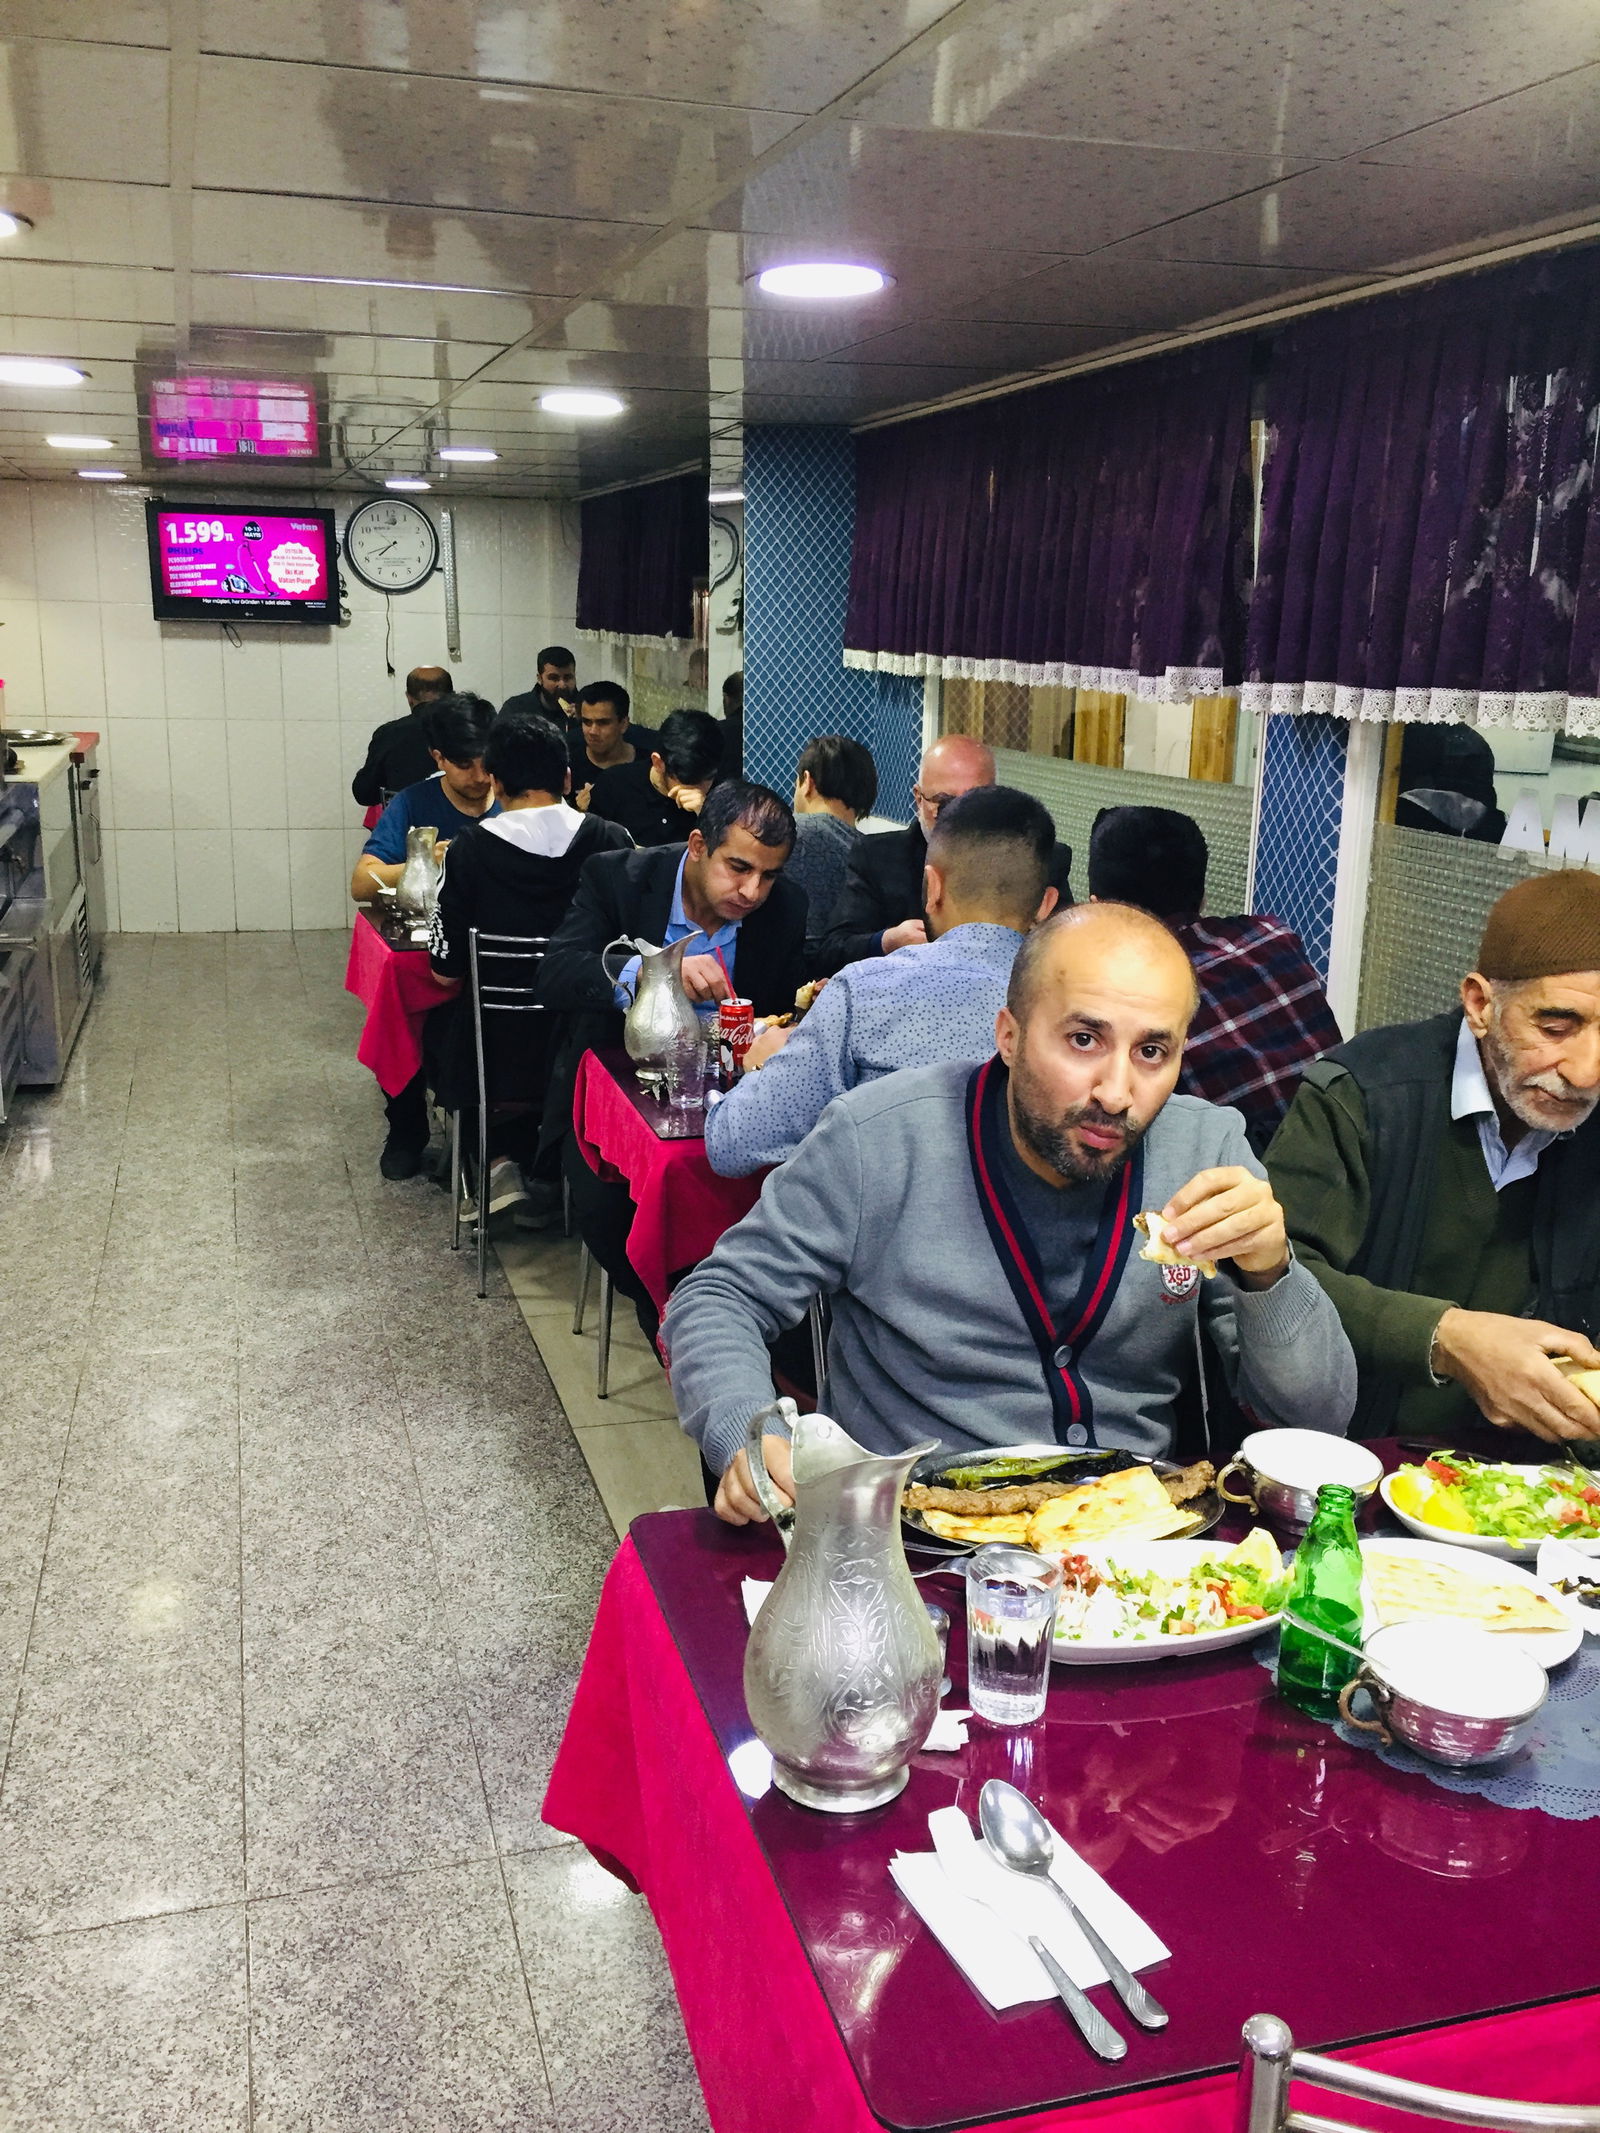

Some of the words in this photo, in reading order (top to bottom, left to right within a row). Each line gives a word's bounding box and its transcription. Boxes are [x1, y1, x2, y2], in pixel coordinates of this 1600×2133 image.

[386, 509, 395, 517] 12
[371, 514, 380, 522] 11
[403, 514, 407, 522] 1
[166, 520, 224, 544] 1.599
[167, 547, 204, 555] PHILIPS
